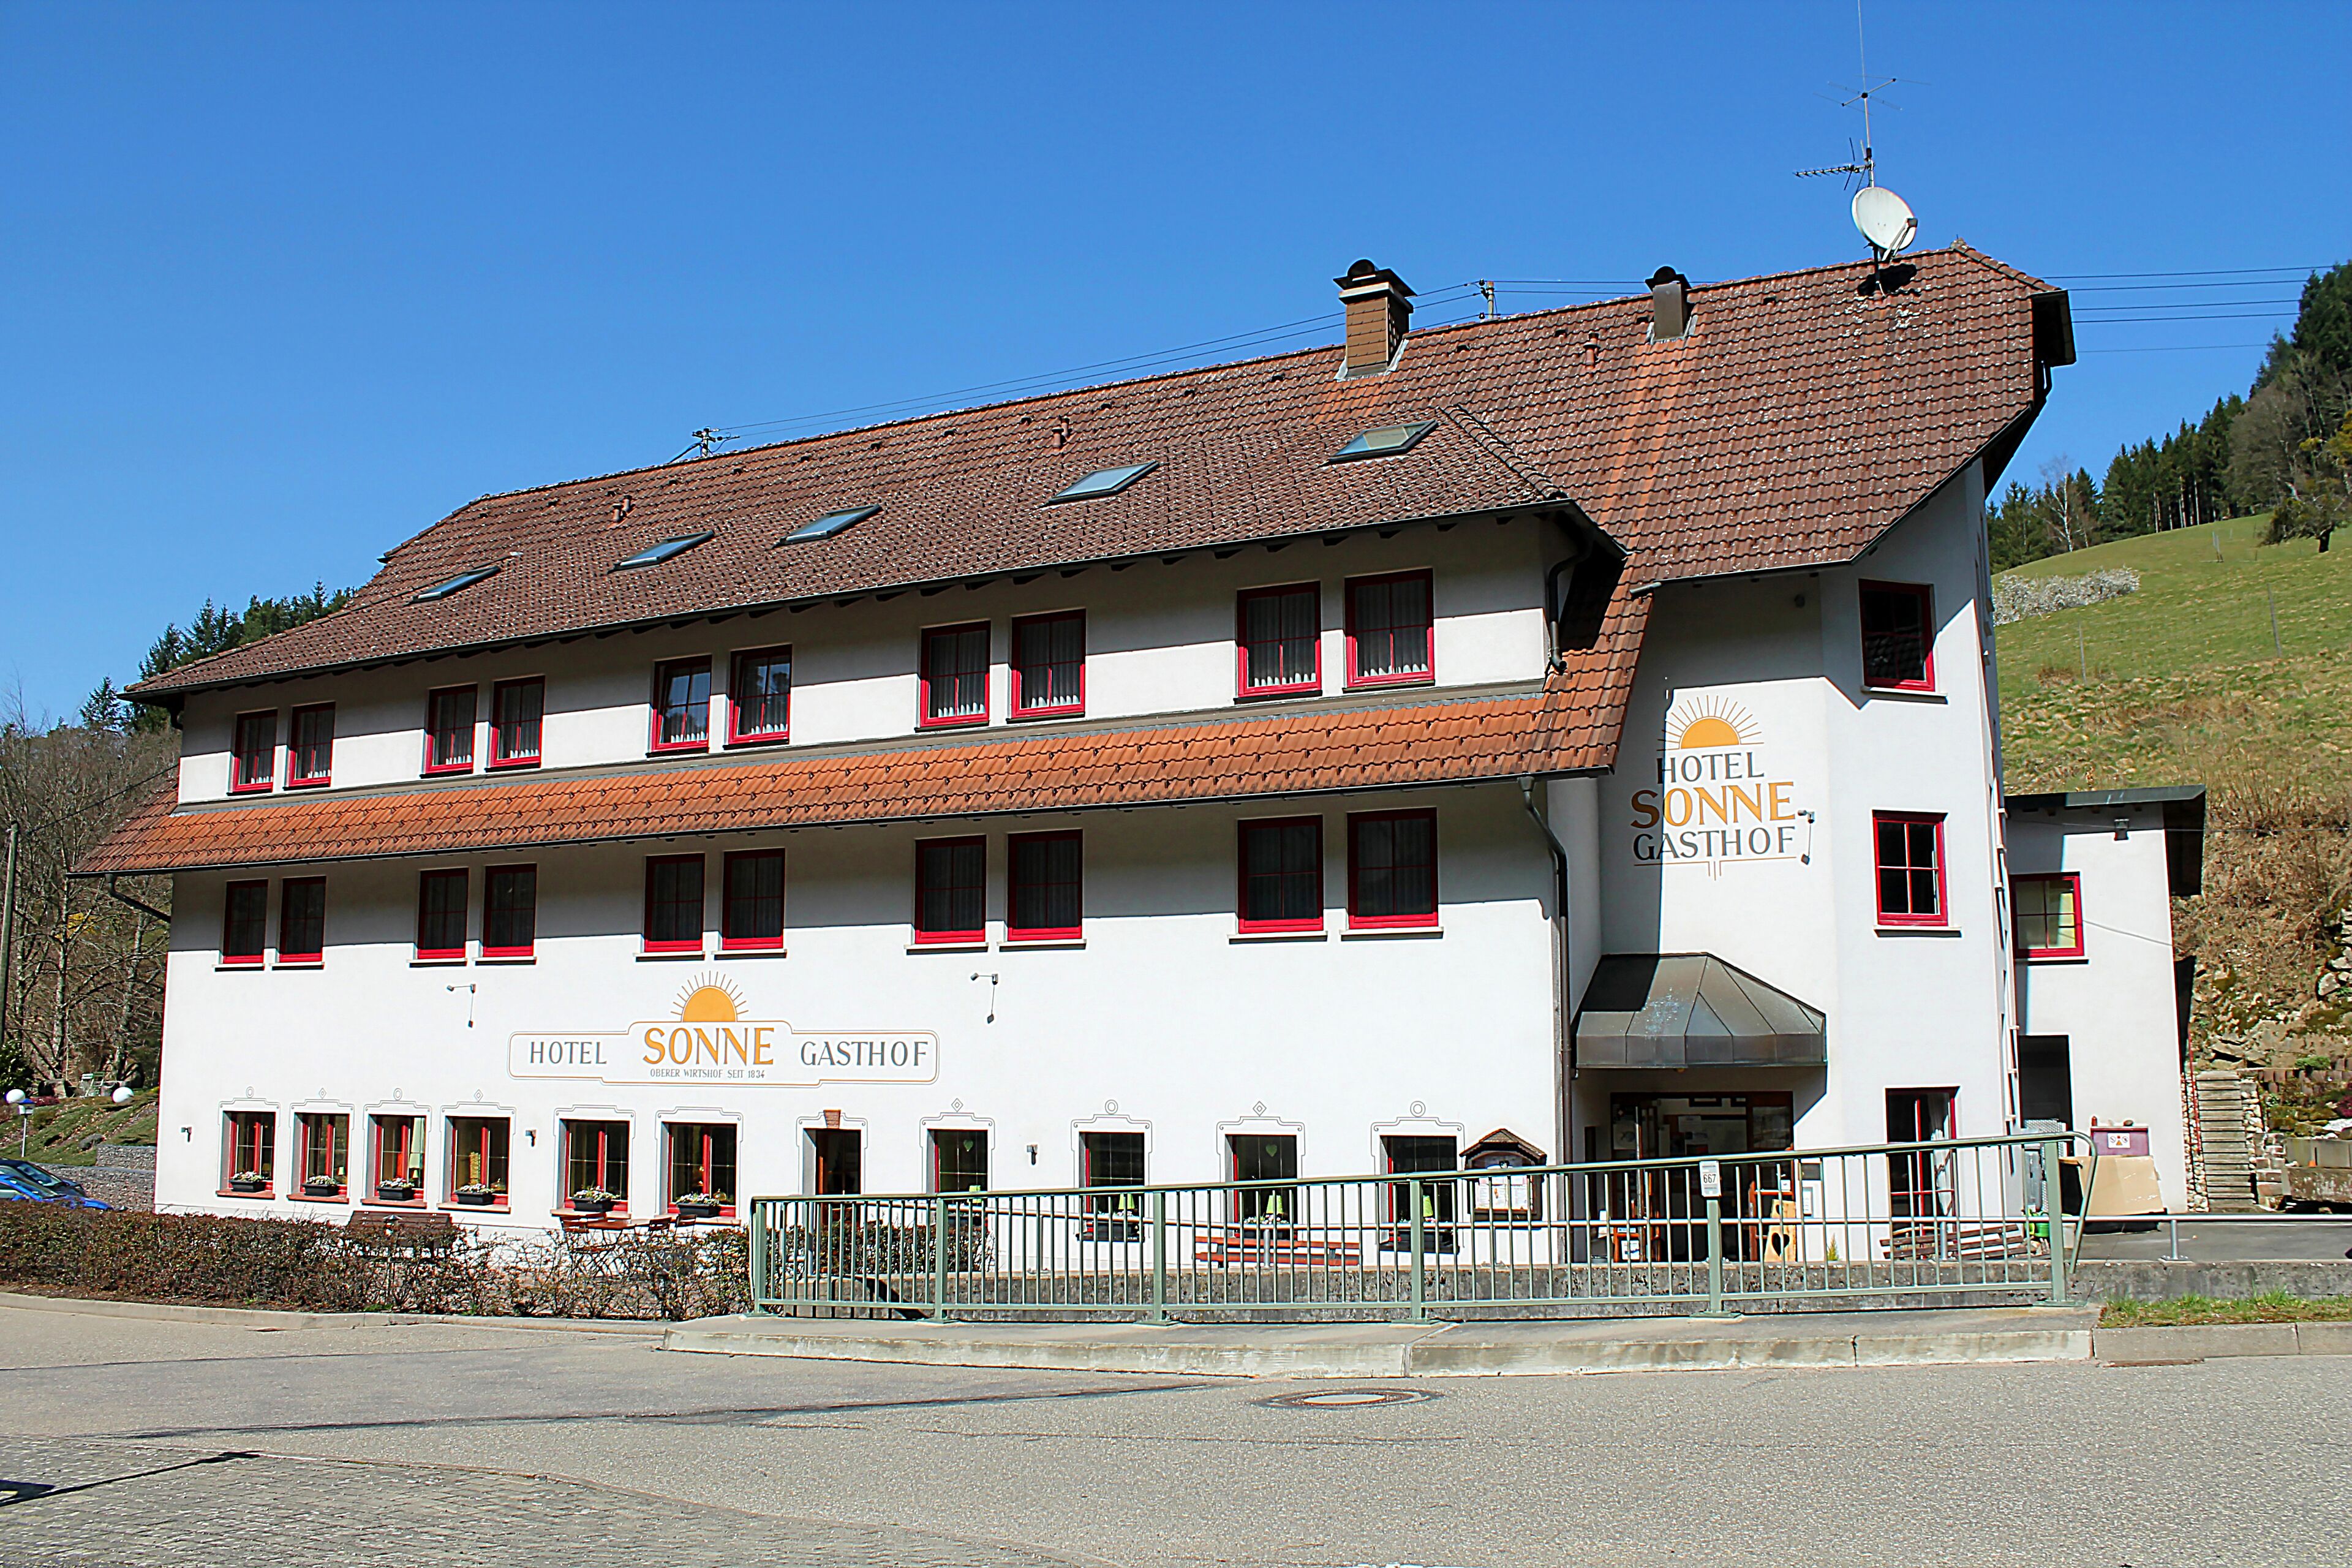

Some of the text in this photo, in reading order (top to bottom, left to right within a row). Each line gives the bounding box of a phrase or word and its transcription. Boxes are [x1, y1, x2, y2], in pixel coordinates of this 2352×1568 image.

[1656, 752, 1765, 785] HOTEL
[1630, 782, 1795, 829] SONNE
[1634, 826, 1795, 861] GASTHOF
[529, 1027, 929, 1067] HOTEL SONNE GASTHOF
[650, 1068, 765, 1079] OBERER WIRTSHOF SEIT 1834
[1703, 1174, 1716, 1183] 667
